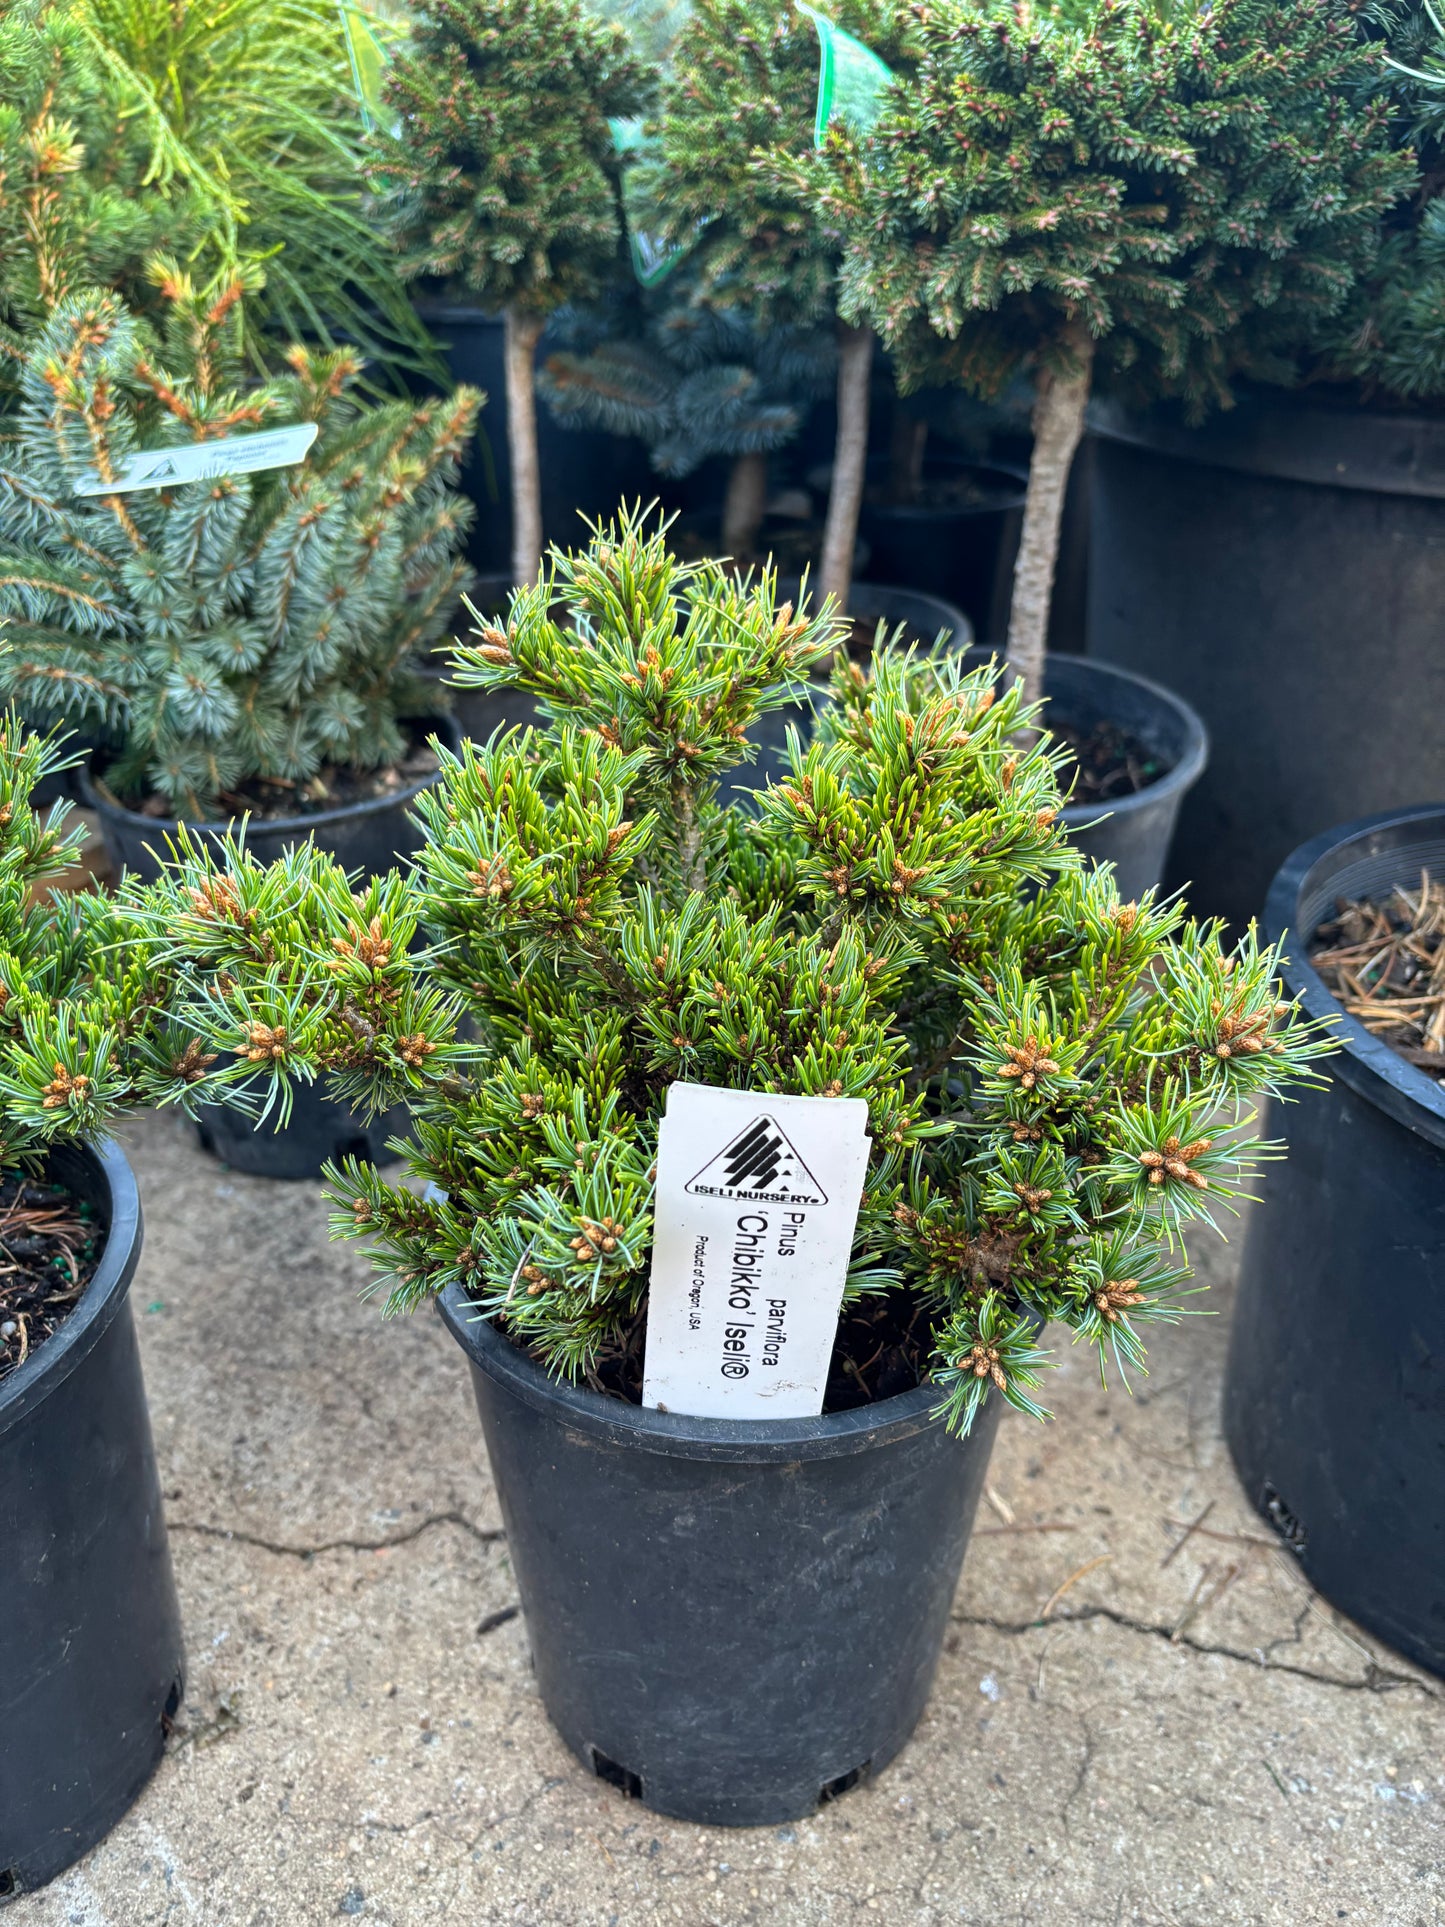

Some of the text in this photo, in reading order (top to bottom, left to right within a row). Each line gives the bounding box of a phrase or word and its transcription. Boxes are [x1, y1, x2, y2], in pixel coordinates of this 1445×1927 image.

[694, 1184, 733, 1197] ISELI
[688, 1235, 709, 1331] Product of Oregon, USA
[721, 1210, 769, 1380] ‘Chibikko’ Iseli®
[762, 1211, 806, 1366] Pinus parviflora
